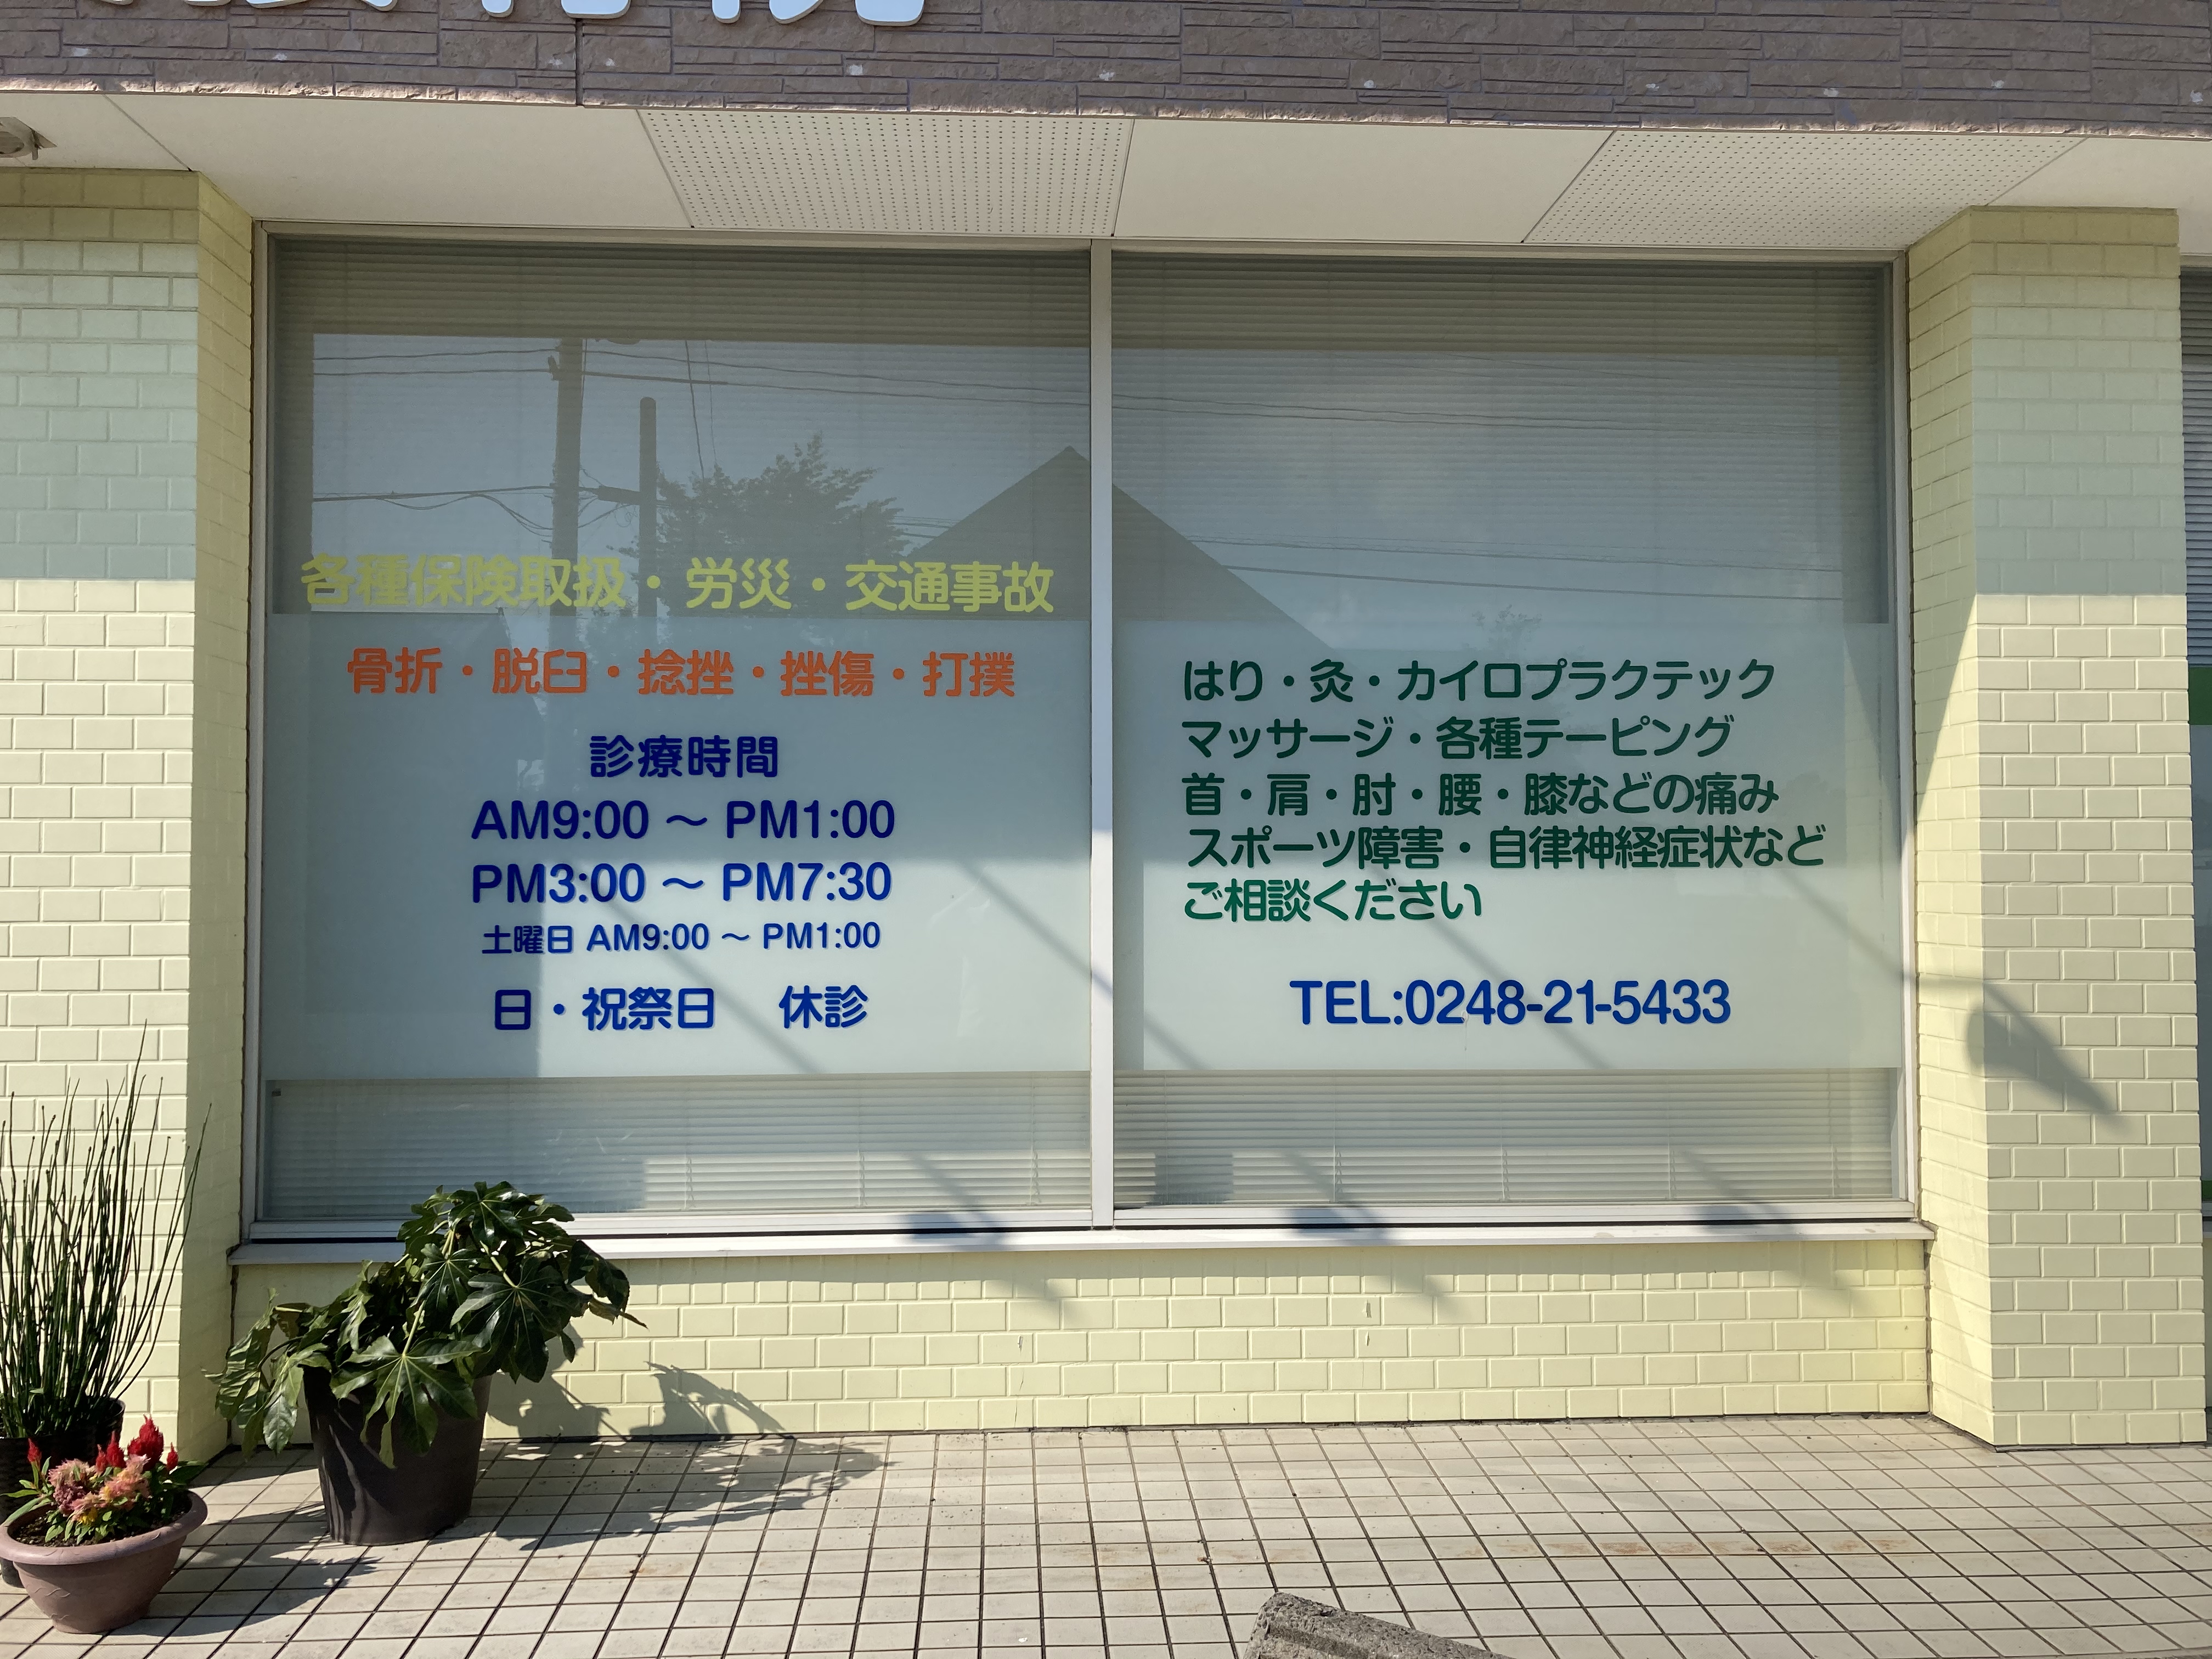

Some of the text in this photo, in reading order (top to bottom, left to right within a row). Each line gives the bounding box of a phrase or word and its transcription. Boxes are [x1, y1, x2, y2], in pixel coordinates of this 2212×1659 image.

[347, 647, 1015, 697] 骨折・脱臼・捻挫・挫傷・打撲
[1183, 659, 1775, 702] はり・灸・カイロプラクテック
[589, 733, 779, 778] 診療時間
[1182, 715, 1735, 760] マッサージ・各種テーピング
[1182, 772, 1779, 816] 首・肩・肘・腰・膝などの痛み
[471, 799, 650, 840] AM9:00
[725, 799, 896, 839] PM1:00
[1187, 825, 1827, 870] スポーツ障害・自律神経症状など
[472, 862, 645, 904] PM3:00
[723, 861, 892, 901] PM7:30
[1183, 878, 1483, 922] ご相談ください
[482, 925, 573, 955] 土曜日
[586, 922, 709, 951] AM9:00
[763, 921, 881, 949] PM1:00
[494, 984, 868, 1031] 日・祝祭日 休診
[1289, 979, 1731, 1026] TEL:0248-21-5433
